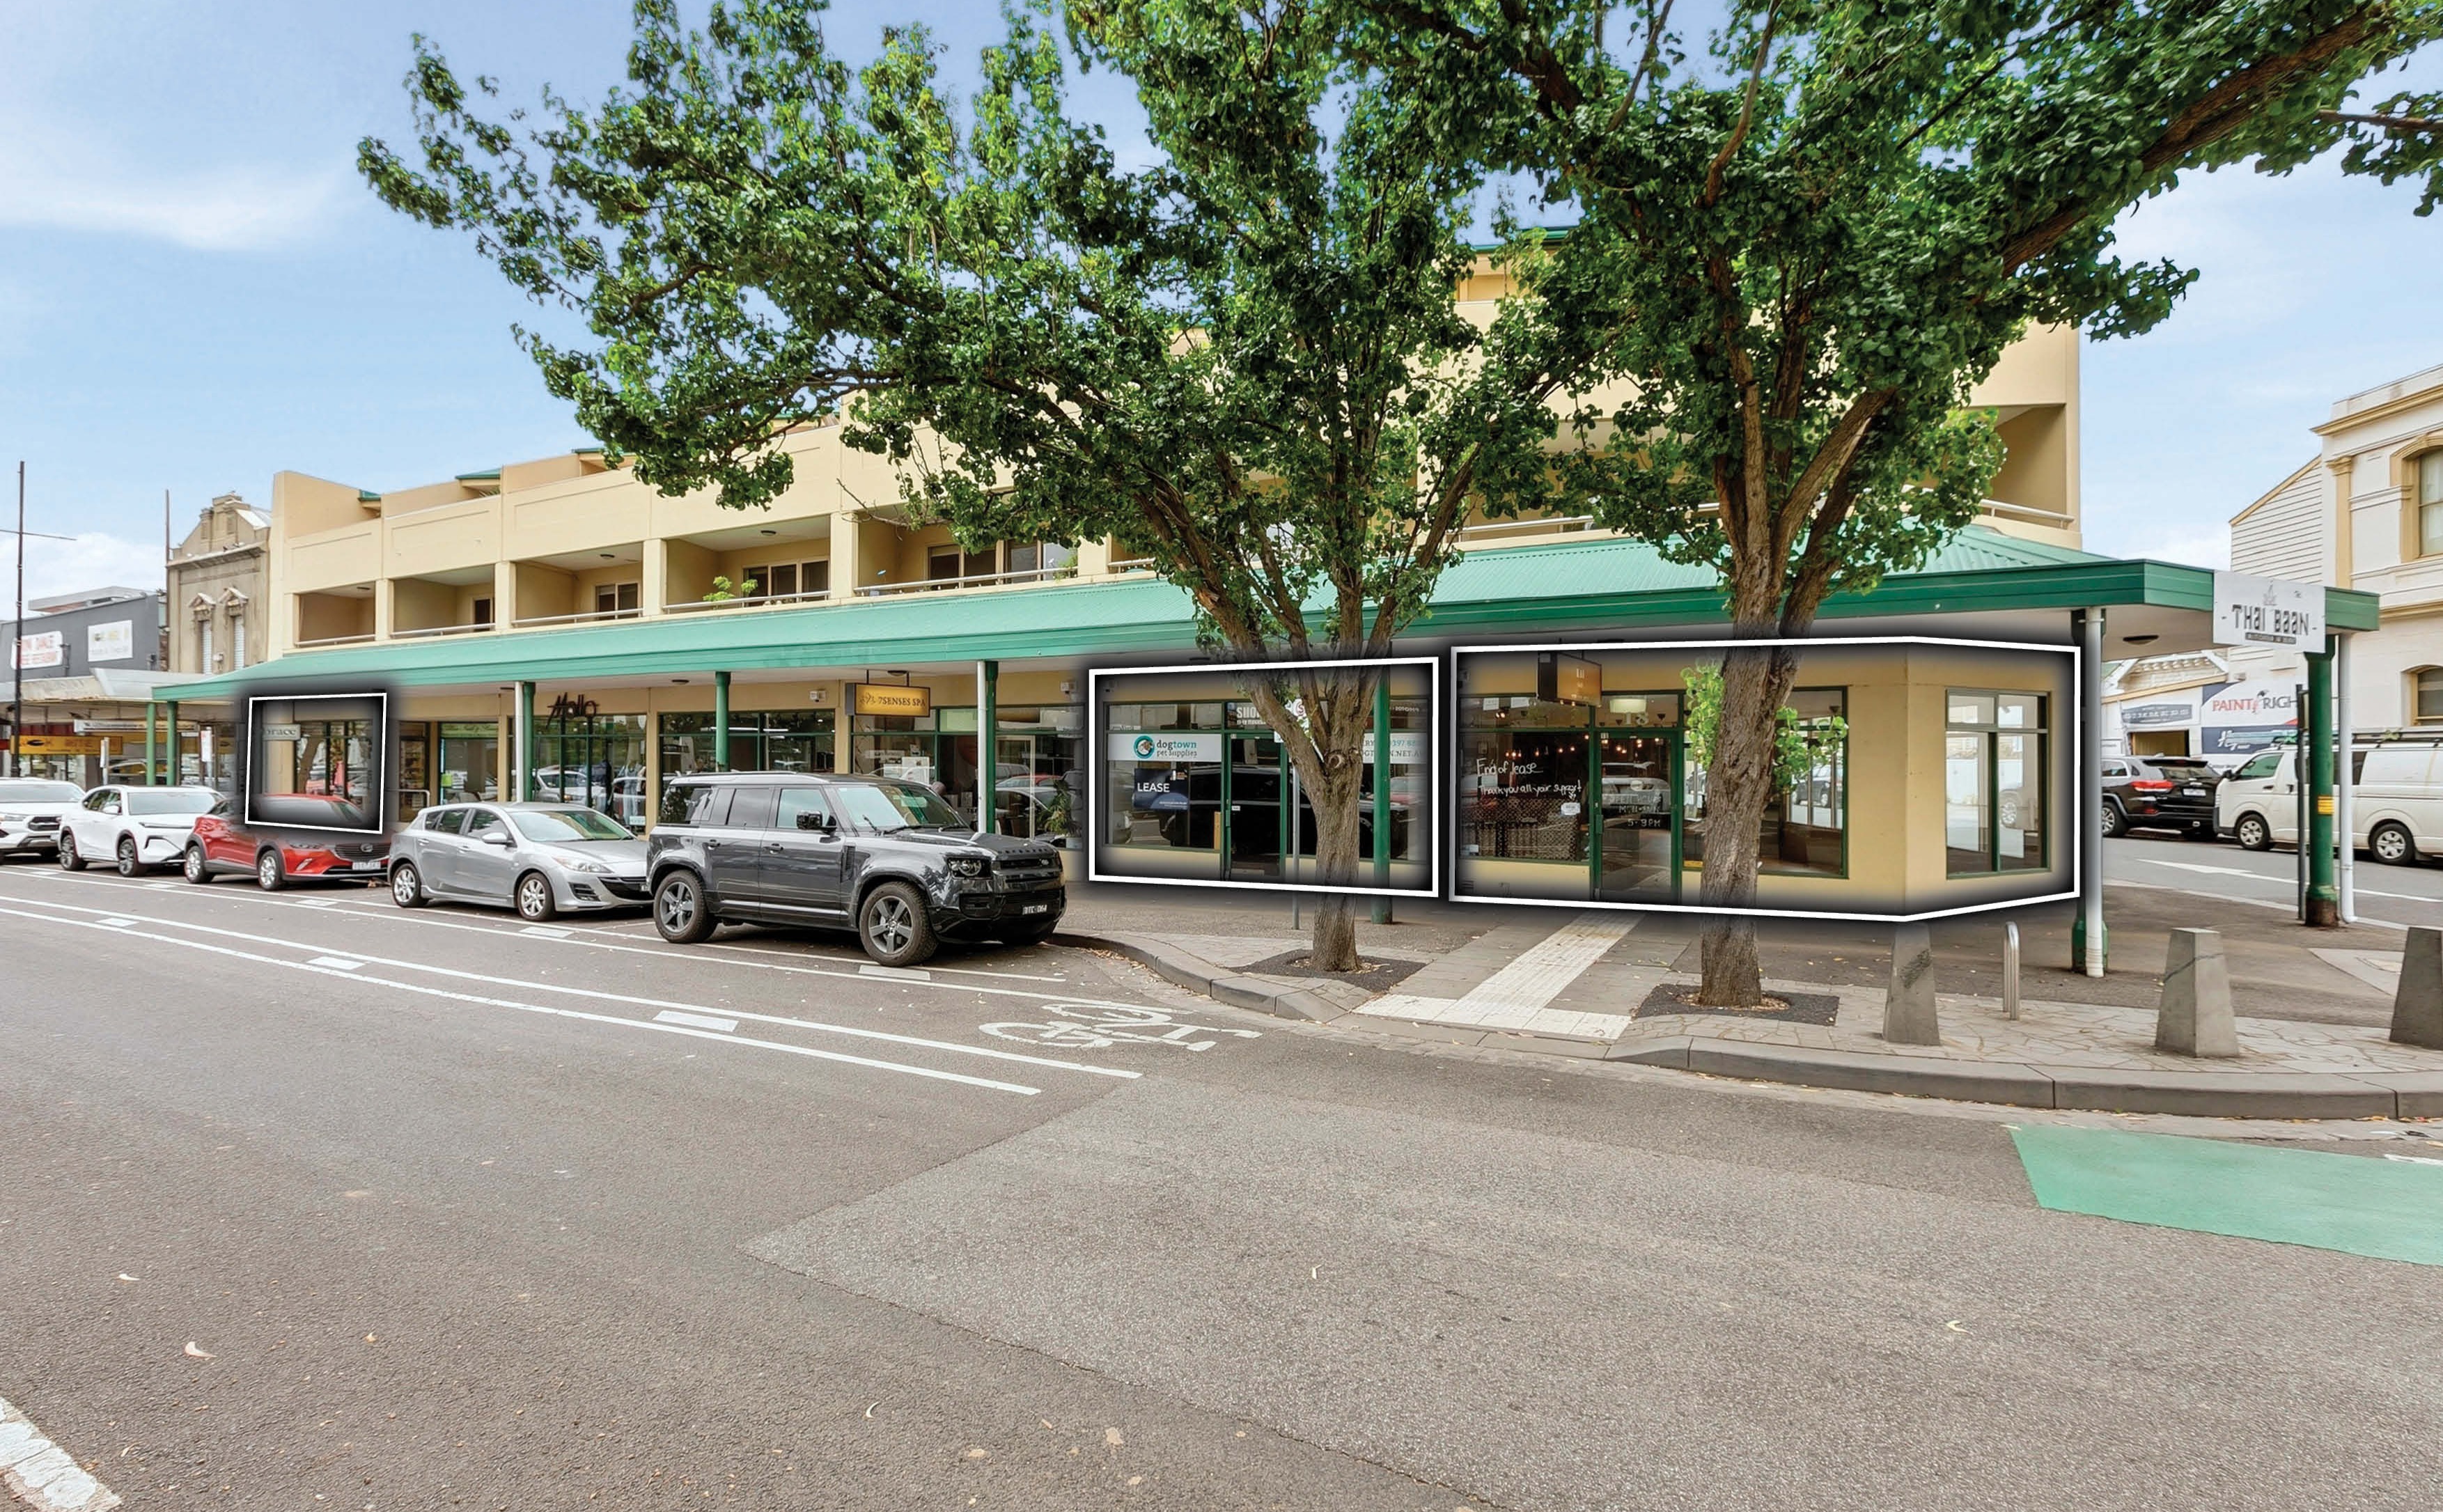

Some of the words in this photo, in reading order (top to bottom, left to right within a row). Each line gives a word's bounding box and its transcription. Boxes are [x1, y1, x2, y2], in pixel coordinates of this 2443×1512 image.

[878, 696, 911, 706] 7SENSES
[912, 698, 926, 707] SPA
[2212, 698, 2254, 712] PAINT
[1156, 739, 1196, 750] dogtown
[1476, 758, 1497, 776] End
[1498, 761, 1509, 774] of
[1137, 782, 1171, 793] LEASE
[1520, 782, 1532, 793] all
